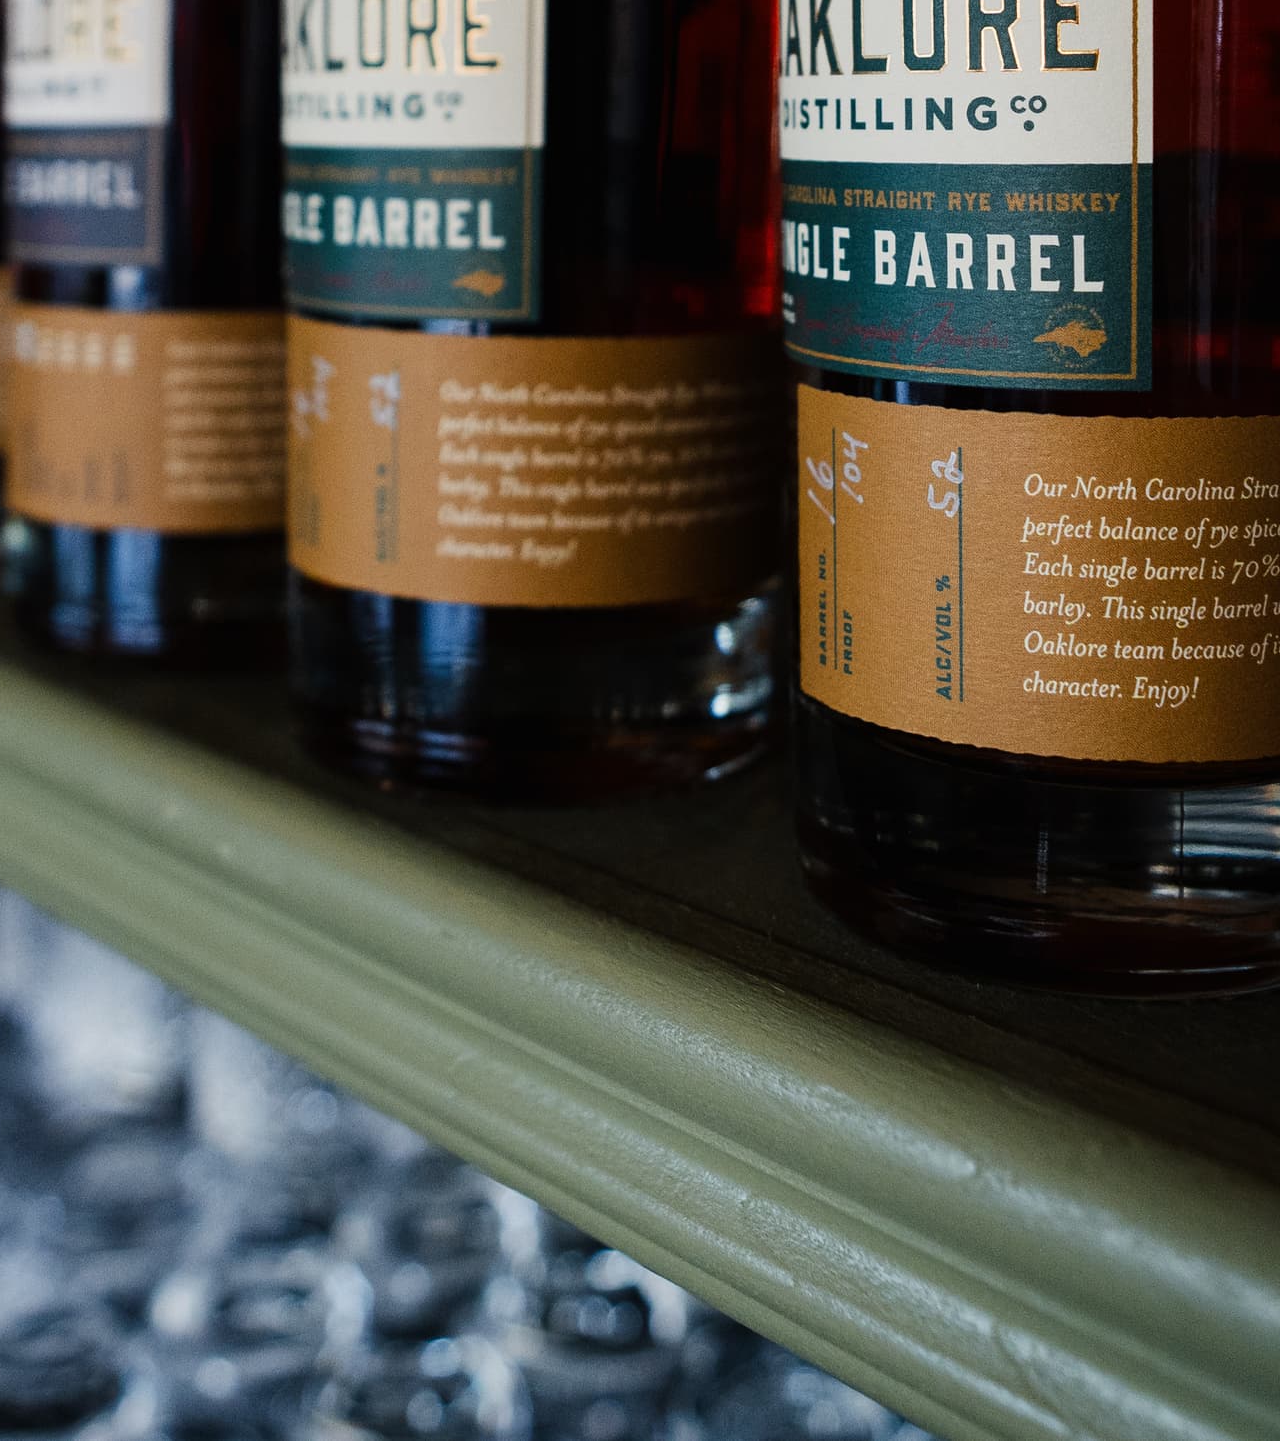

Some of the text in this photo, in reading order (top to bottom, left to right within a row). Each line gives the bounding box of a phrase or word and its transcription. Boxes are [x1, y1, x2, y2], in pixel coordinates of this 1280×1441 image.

[331, 194, 507, 250] BARREL
[844, 188, 936, 211] STRAIGHT
[948, 191, 992, 212] RYE
[1006, 192, 1121, 214] WHISKEY
[781, 219, 1104, 293] NGLE BARREL
[806, 457, 836, 525] 16
[841, 431, 869, 505] 104
[926, 450, 964, 518] 52
[1023, 472, 1067, 498] Our
[1070, 475, 1138, 500] North
[1145, 477, 1236, 501] Carolina
[1020, 514, 1093, 546] perfect
[1098, 516, 1179, 540] balance
[1184, 517, 1211, 549] of
[1209, 524, 1239, 549] rye
[1022, 551, 1073, 577] Each
[1078, 556, 1138, 588] single
[1143, 557, 1206, 581] barrel
[1210, 559, 1226, 580] is
[1231, 553, 1280, 585] 70%
[817, 589, 828, 666] BARREL
[1023, 590, 1092, 625] barley.
[1101, 595, 1145, 619] This
[1149, 596, 1207, 629] single
[1212, 593, 1269, 620] barrel
[842, 609, 854, 676] PROOF
[934, 600, 953, 701] ALC/VOL
[1023, 630, 1109, 658] Oaklore
[1114, 639, 1165, 660] team
[1171, 636, 1245, 660] because
[1249, 632, 1273, 665] of
[1022, 670, 1201, 708] character. Enjoy!
